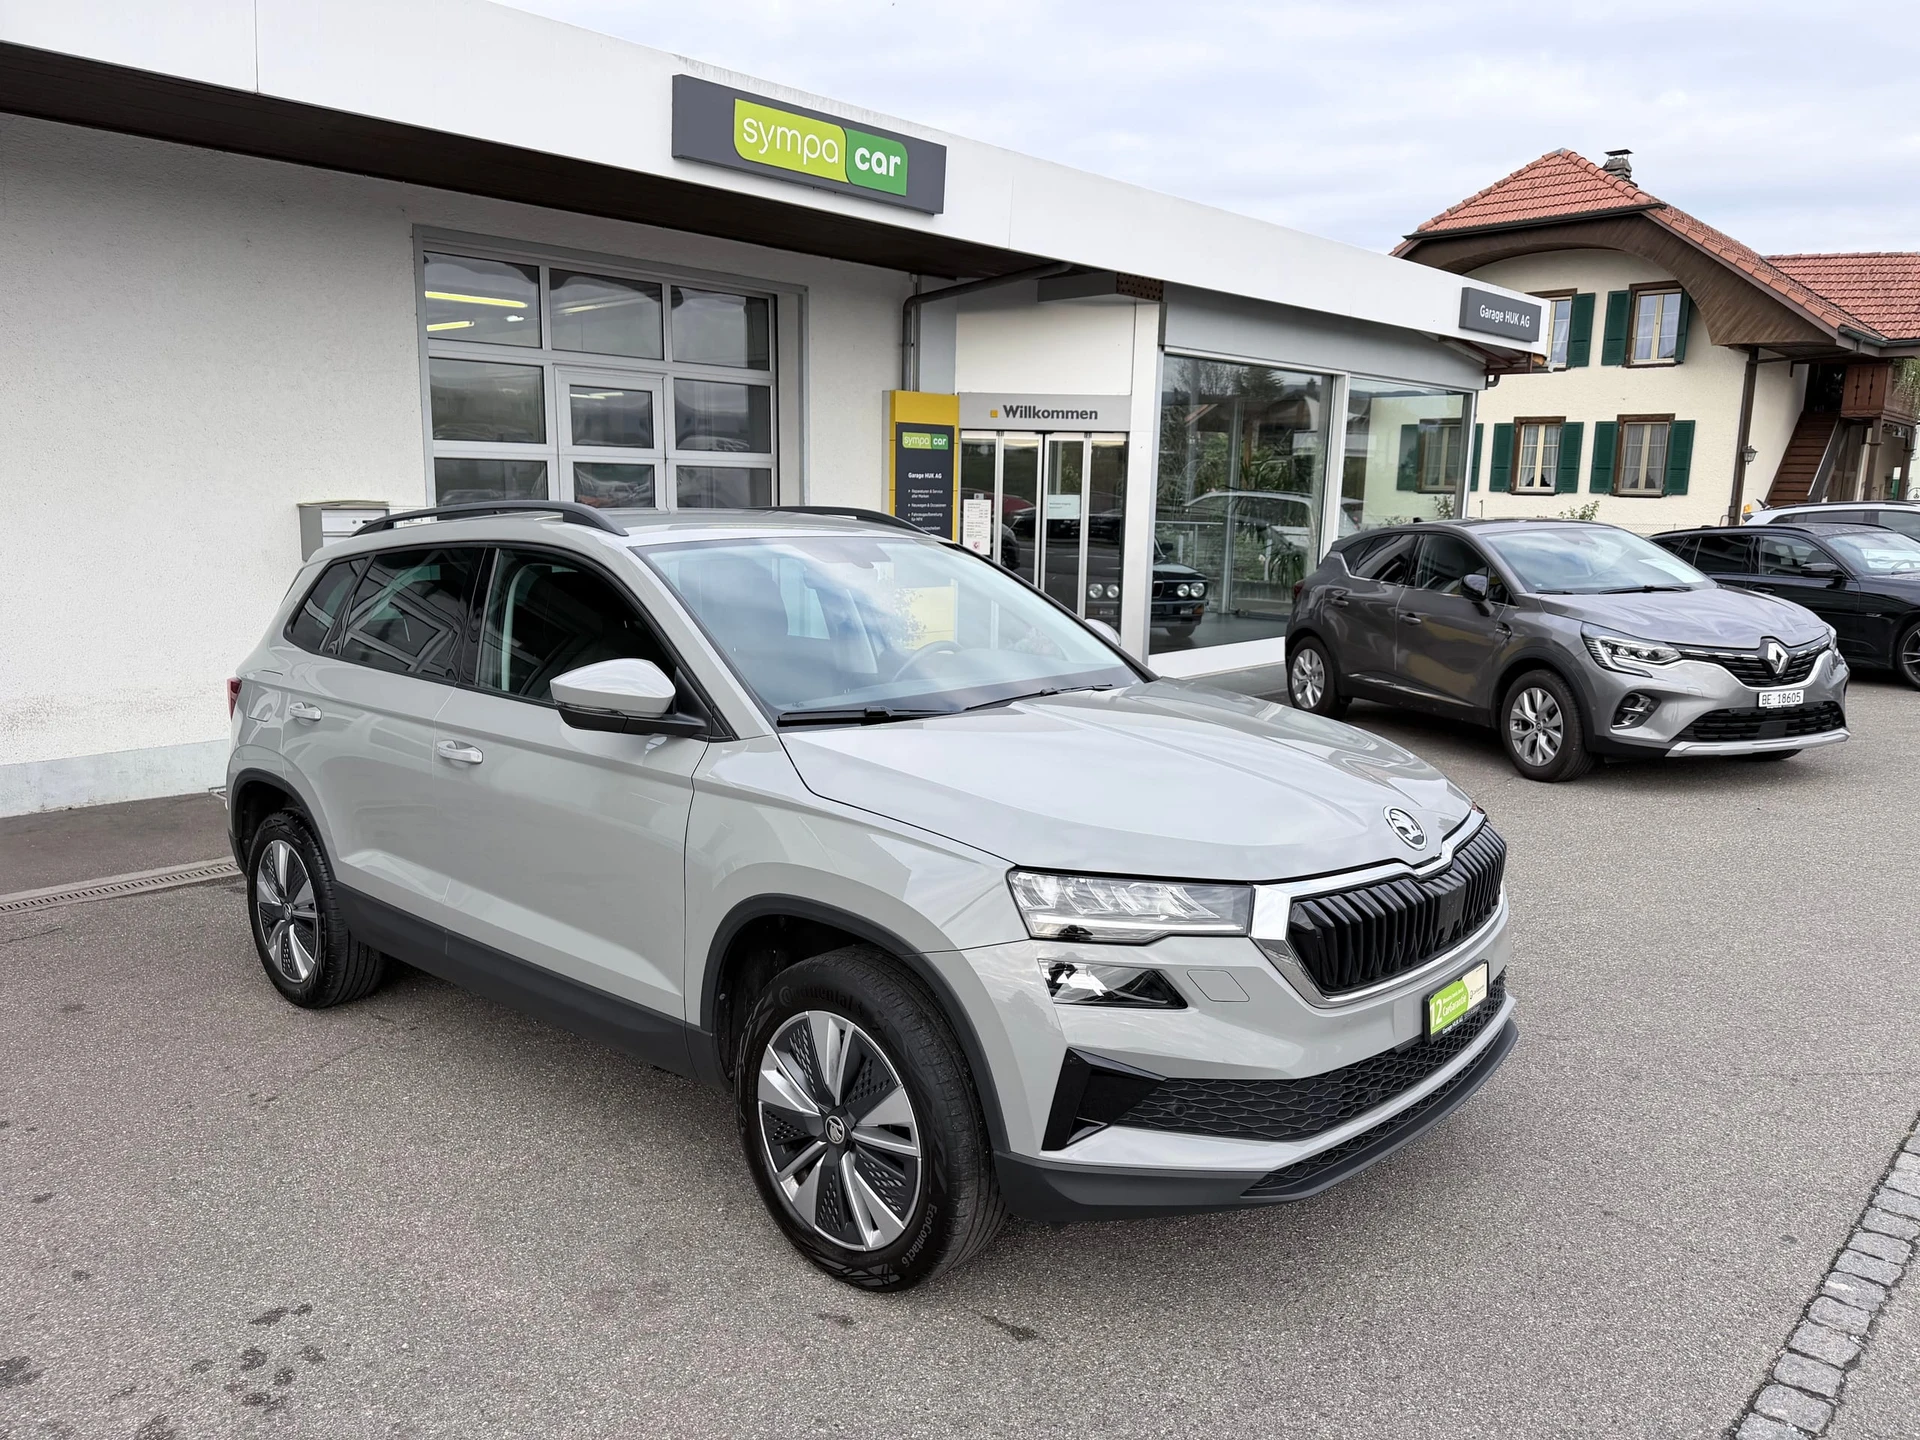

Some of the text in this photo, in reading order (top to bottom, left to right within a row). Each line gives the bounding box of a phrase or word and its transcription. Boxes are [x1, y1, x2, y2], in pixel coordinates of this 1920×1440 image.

[743, 117, 901, 177] sympa car
[1479, 304, 1530, 327] Garage HUK AG
[1002, 405, 1099, 420] Willkommen
[904, 436, 930, 446] sympa
[1762, 692, 1801, 705] BE 18605
[1430, 998, 1443, 1028] 12
[901, 1203, 938, 1268] EcoContact 6
